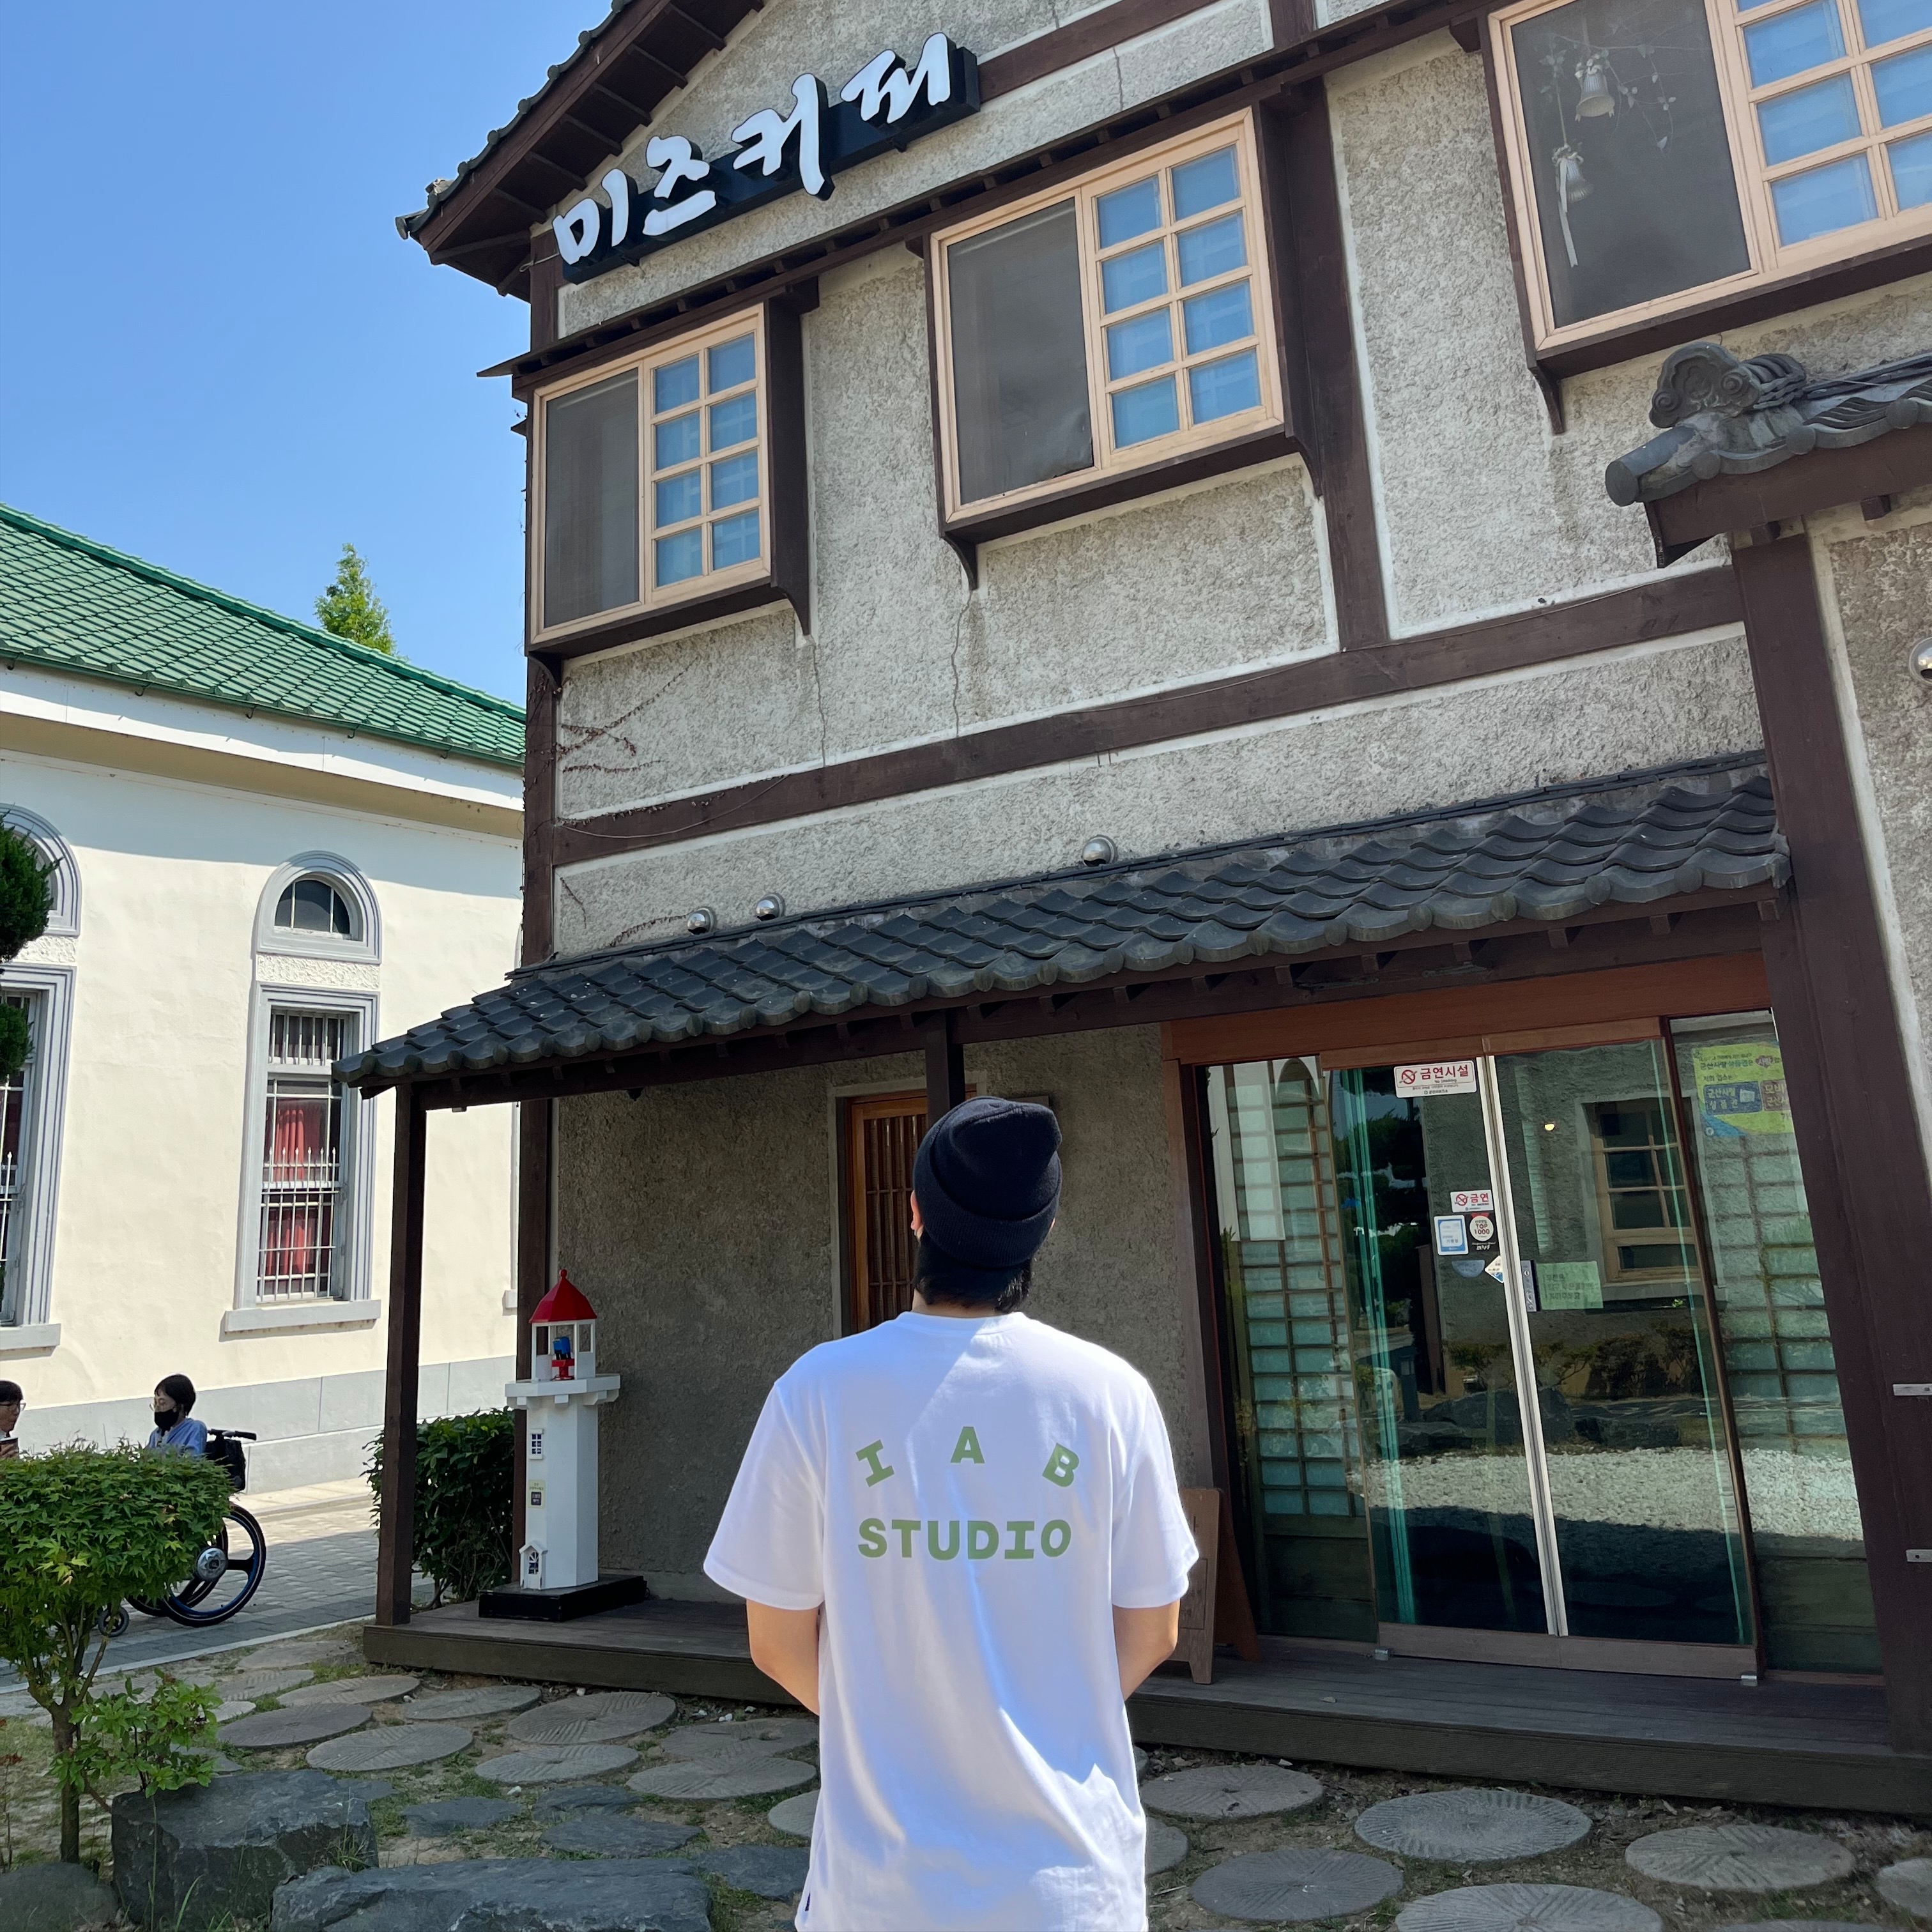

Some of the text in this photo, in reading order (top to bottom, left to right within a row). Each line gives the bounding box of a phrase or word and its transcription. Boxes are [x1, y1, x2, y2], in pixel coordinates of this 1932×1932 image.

[1420, 1065, 1468, 1080] 금연시설
[1470, 1193, 1489, 1203] 금연
[858, 1518, 1071, 1561] STUDIO
